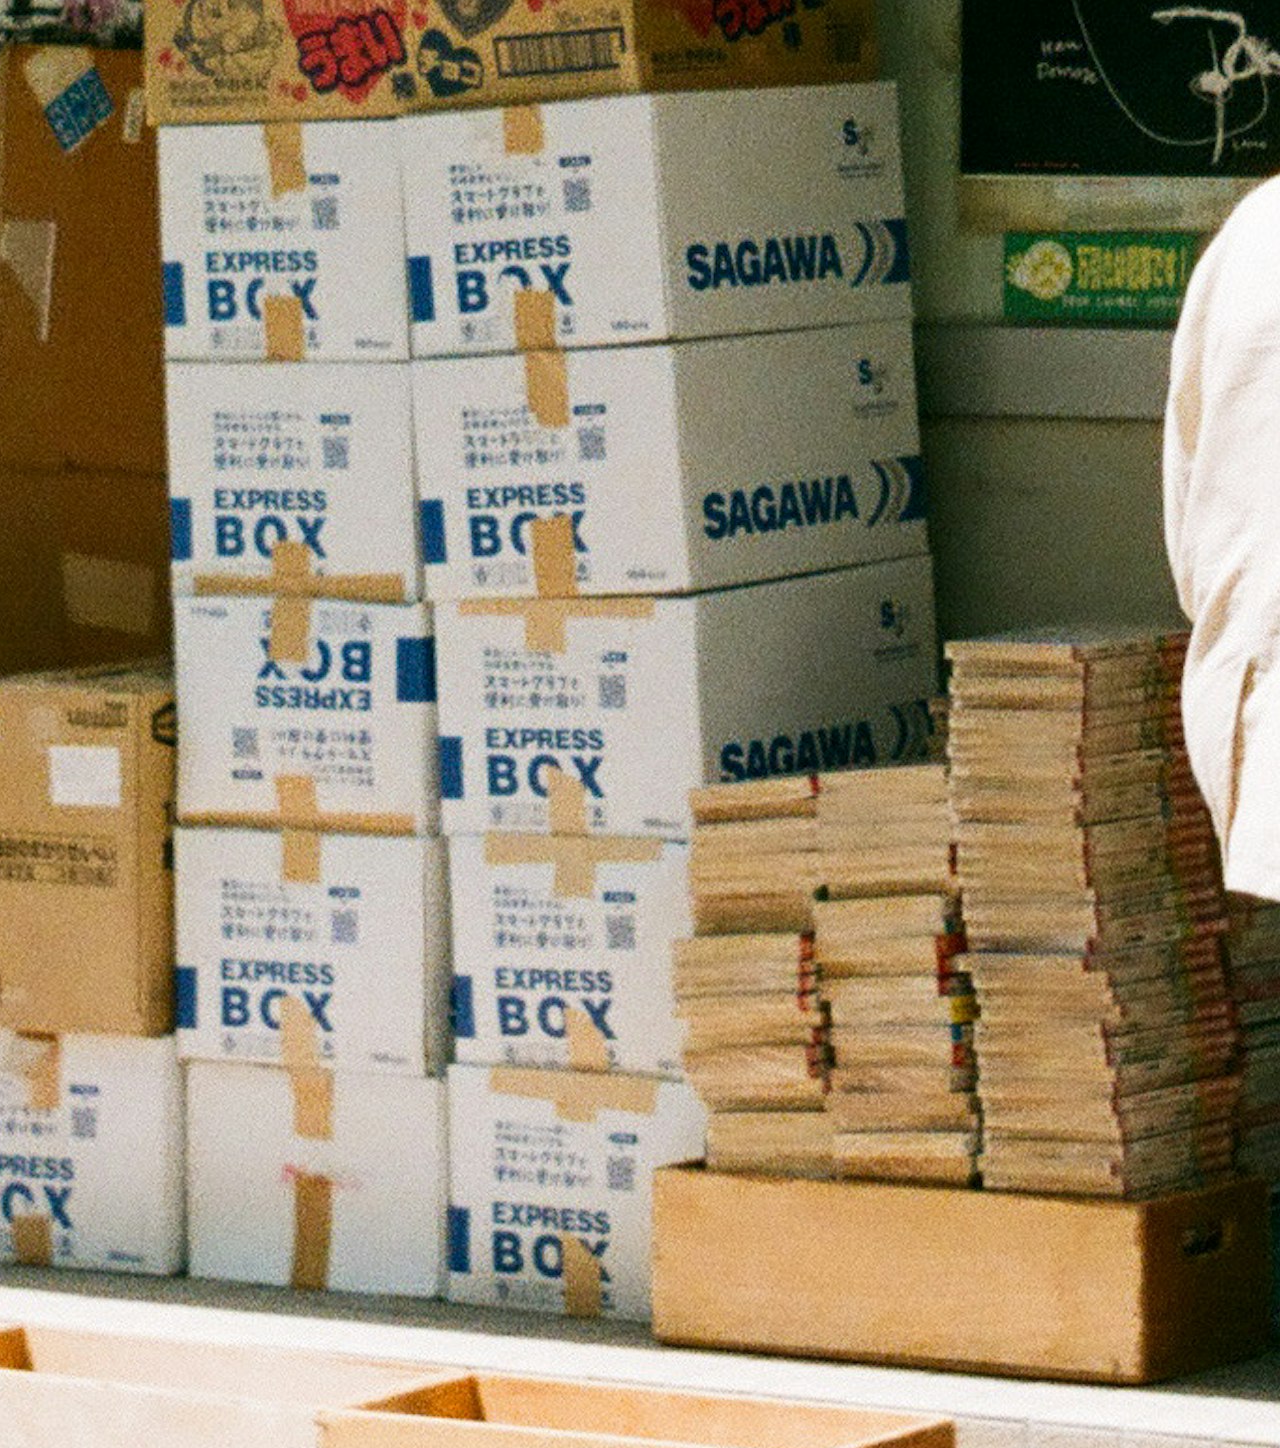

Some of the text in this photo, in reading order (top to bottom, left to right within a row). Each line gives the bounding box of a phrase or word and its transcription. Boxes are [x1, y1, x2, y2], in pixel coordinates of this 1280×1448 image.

[297, 6, 408, 93] うまい
[205, 250, 318, 274] EXPRESS
[454, 235, 571, 265] EXPRESS
[685, 234, 843, 291] SAGAWA
[213, 488, 328, 512] EXPRESS
[466, 483, 586, 510] EXPRESS
[702, 475, 859, 540] SAGAWA
[214, 513, 327, 560] BOX
[255, 683, 373, 712] EXPRESS
[485, 726, 604, 752] EXPRESS
[720, 721, 877, 784] SAGAWA
[487, 754, 605, 799] BOX
[220, 958, 336, 987] EXPRESS
[494, 966, 614, 994] EXPRESS
[497, 996, 616, 1041] BOX
[491, 1202, 611, 1235] EXPRESS
